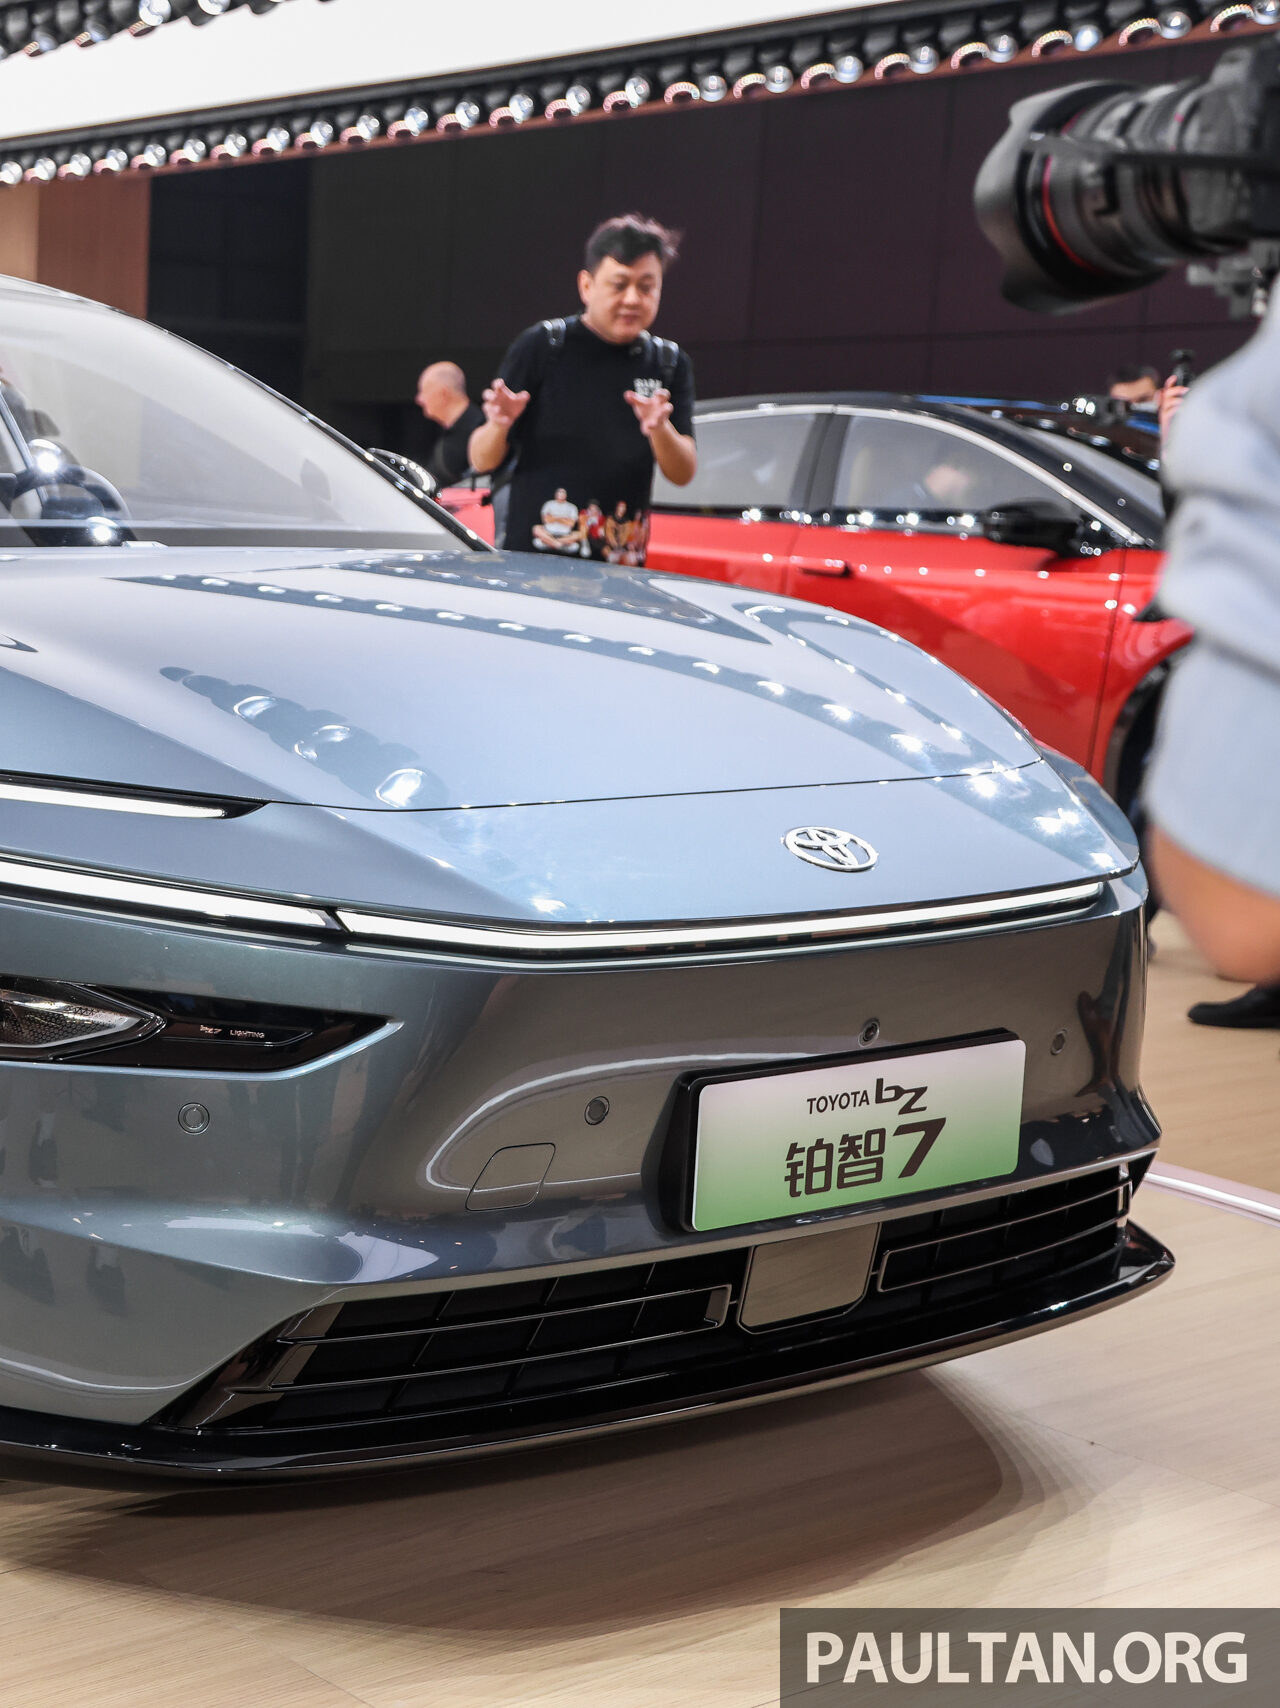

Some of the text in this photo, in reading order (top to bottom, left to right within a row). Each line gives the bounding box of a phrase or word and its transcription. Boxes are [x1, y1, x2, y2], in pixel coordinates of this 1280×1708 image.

[229, 1029, 265, 1039] LIGHTING
[807, 1089, 870, 1115] TOYOTA
[784, 1117, 947, 1198] 铂智7
